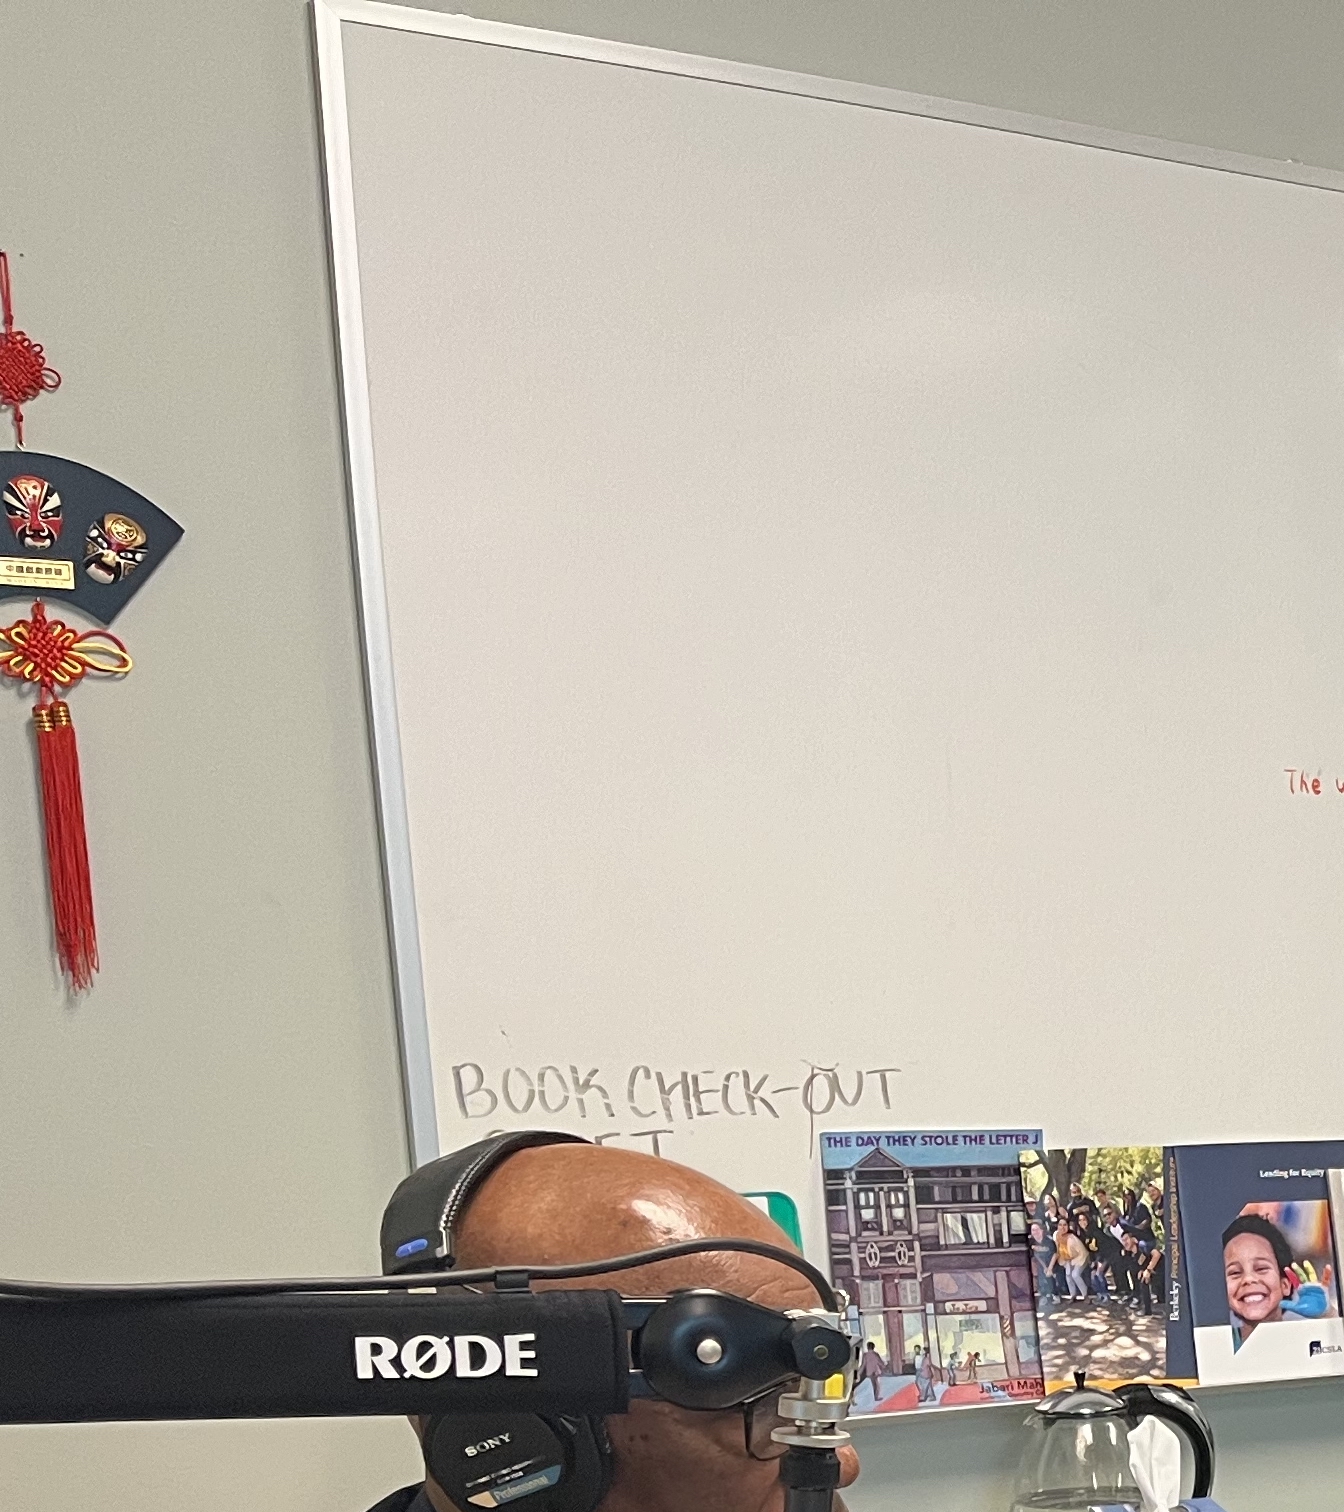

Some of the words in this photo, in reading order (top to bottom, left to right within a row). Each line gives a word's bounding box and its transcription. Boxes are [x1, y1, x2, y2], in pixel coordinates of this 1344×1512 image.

[1284, 768, 1322, 797] The
[451, 1061, 616, 1120] BOOK
[625, 1059, 903, 1144] CHECK-OUT
[826, 1136, 851, 1148] THE
[855, 1135, 882, 1147] DAY
[885, 1135, 917, 1147] THEY
[921, 1134, 959, 1146] STOLE
[962, 1133, 986, 1145] THE
[989, 1133, 1029, 1145] LETTER
[1032, 1133, 1039, 1145] J
[354, 1333, 539, 1380] RØDE
[979, 1380, 1015, 1394] Jabari
[464, 1432, 511, 1457] SONY
